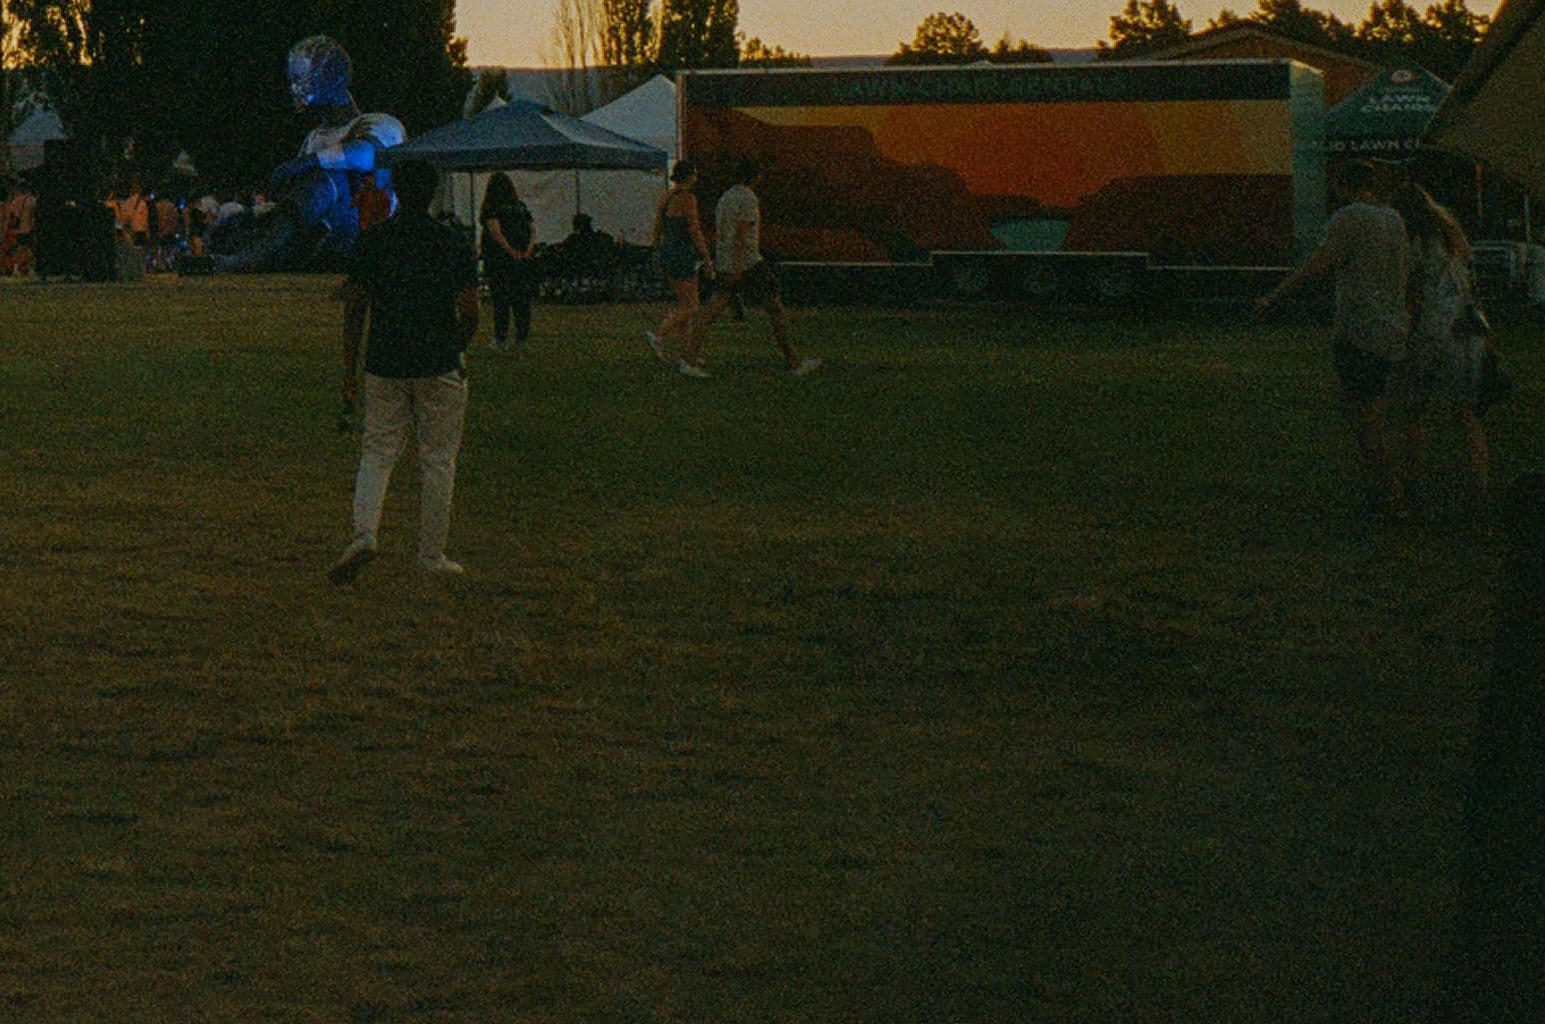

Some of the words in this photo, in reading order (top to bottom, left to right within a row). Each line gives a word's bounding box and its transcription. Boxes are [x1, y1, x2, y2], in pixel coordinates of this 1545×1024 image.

[831, 77, 908, 97] LAWN
[916, 76, 999, 96] CHAIR
[1007, 74, 1127, 94] RENTALS
[1368, 94, 1430, 104] LAWN
[1351, 140, 1400, 151] LAWN
